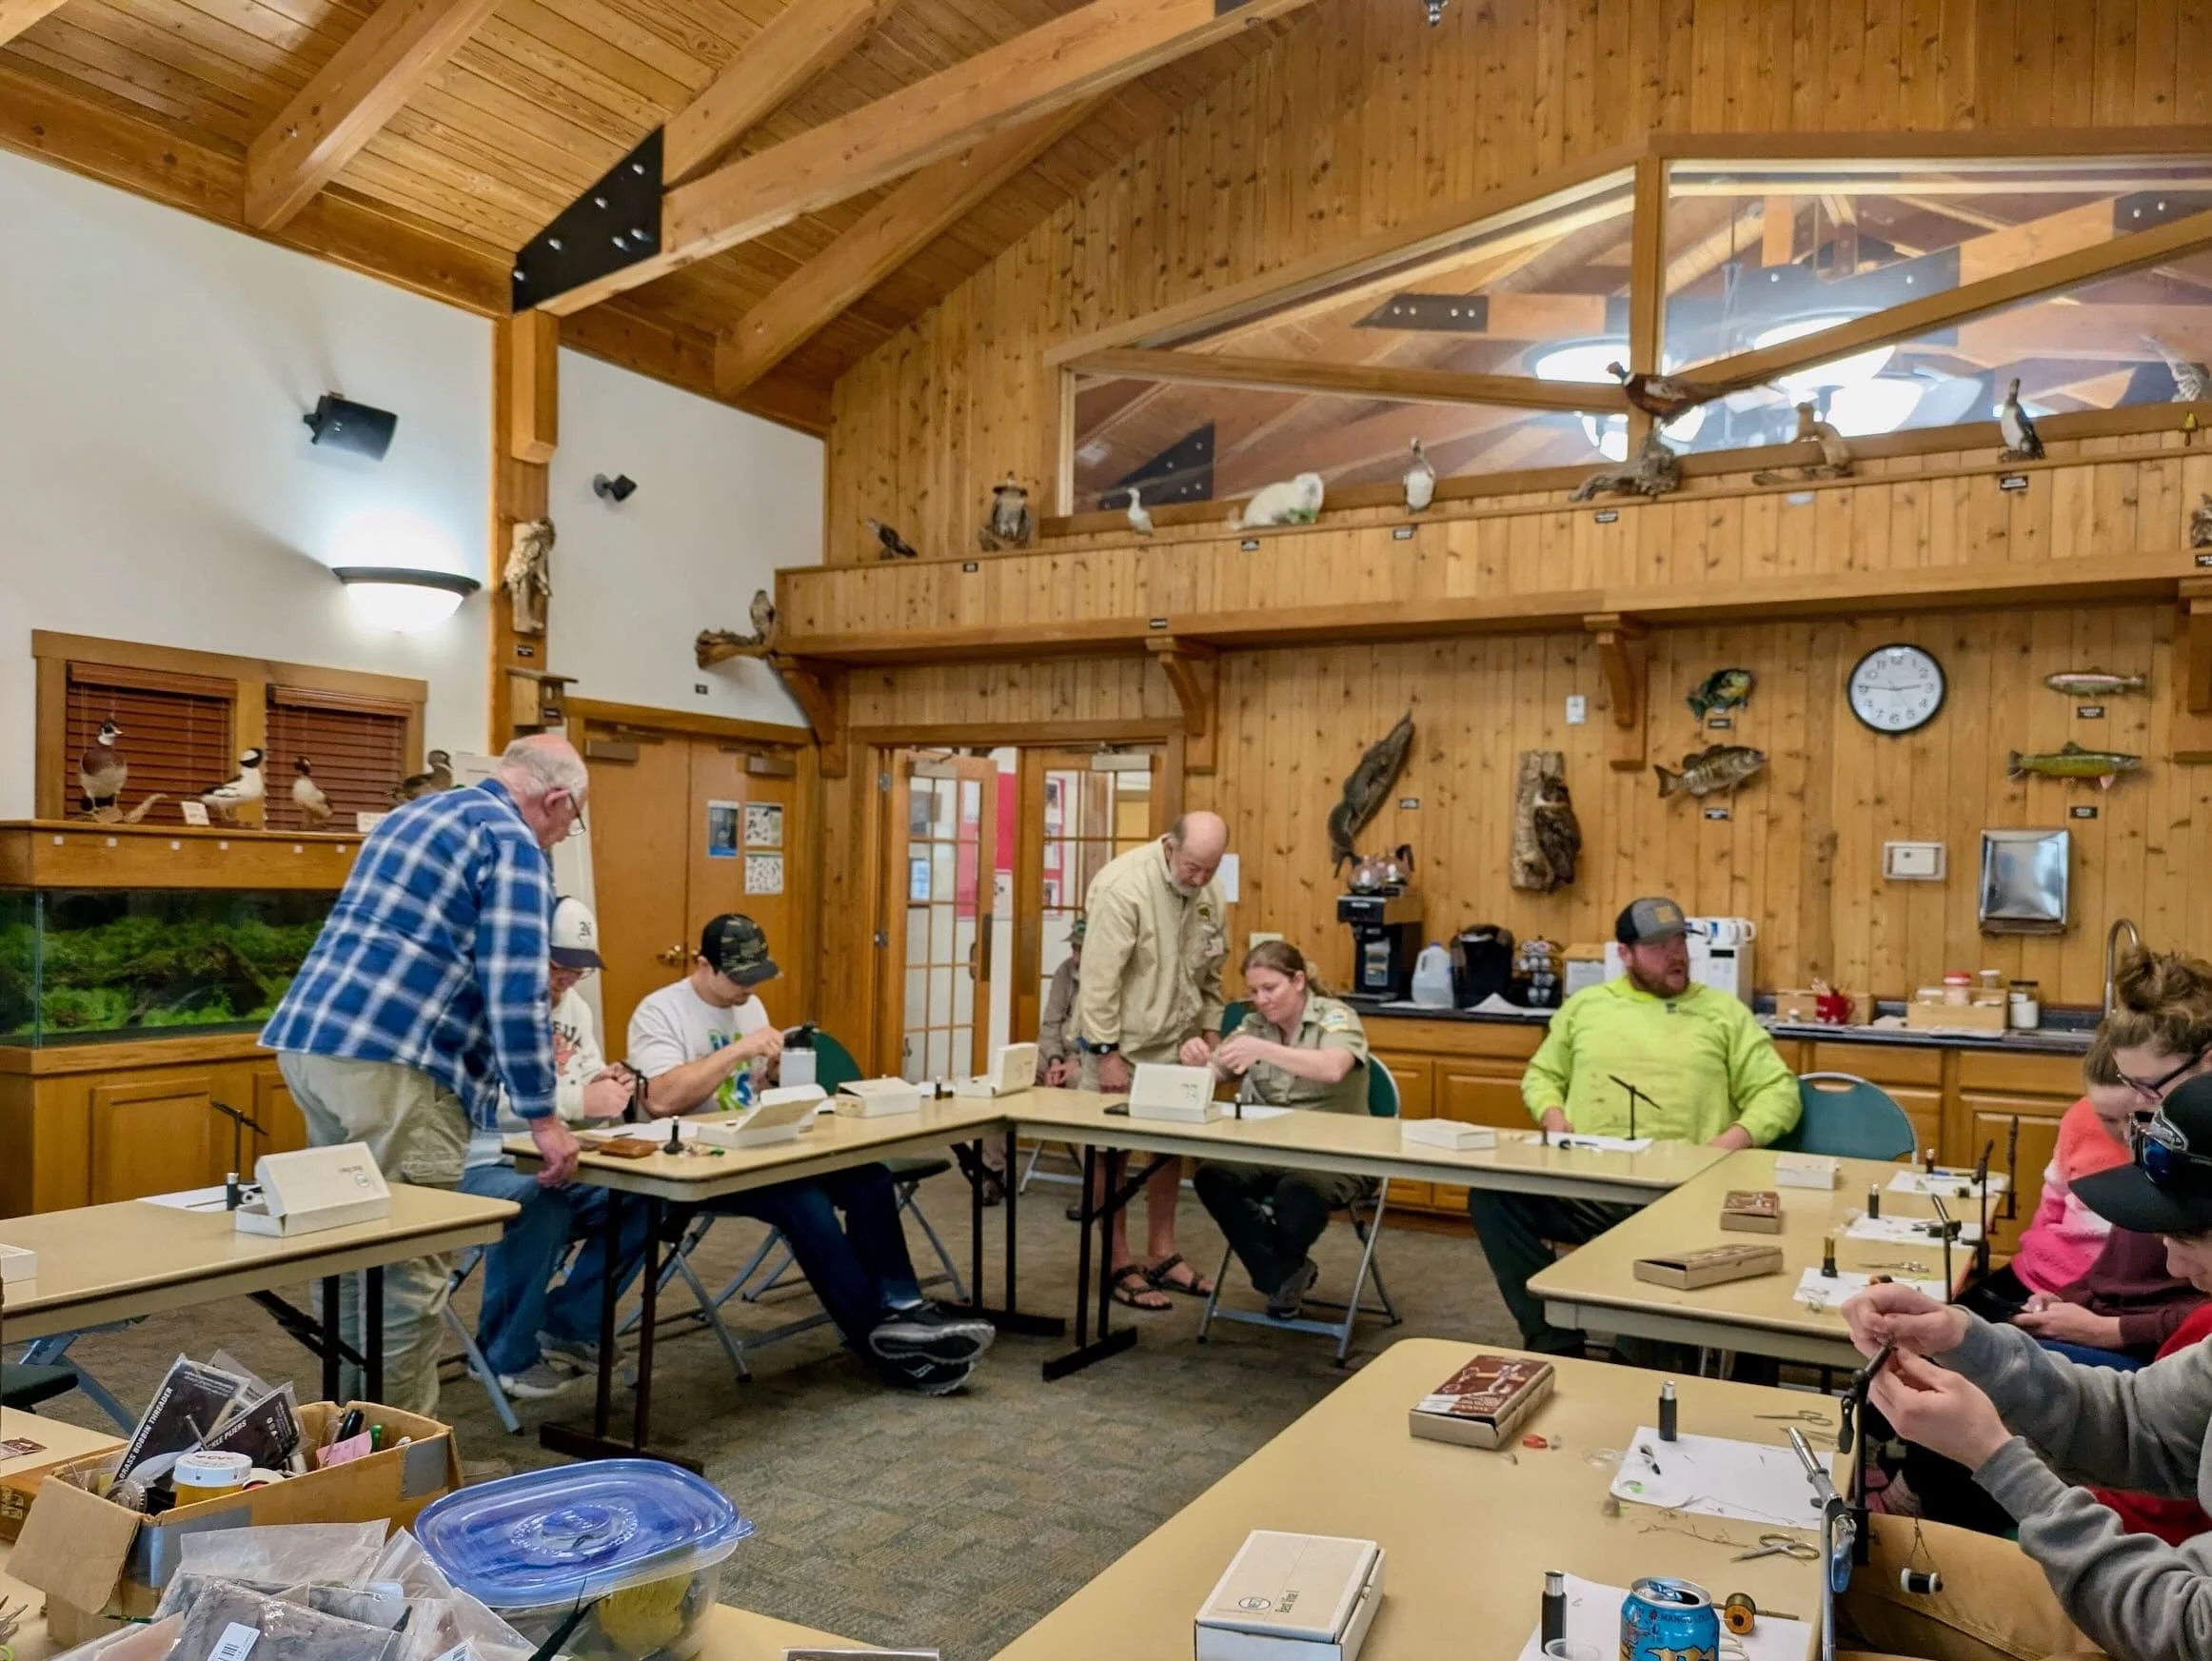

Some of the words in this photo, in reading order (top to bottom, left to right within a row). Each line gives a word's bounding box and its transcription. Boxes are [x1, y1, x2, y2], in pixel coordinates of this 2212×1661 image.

[118, 1454, 136, 1480] BRASS
[132, 1424, 152, 1454] BOBBIN
[148, 1386, 173, 1425] THREADER
[224, 1419, 247, 1440] PLIERS
